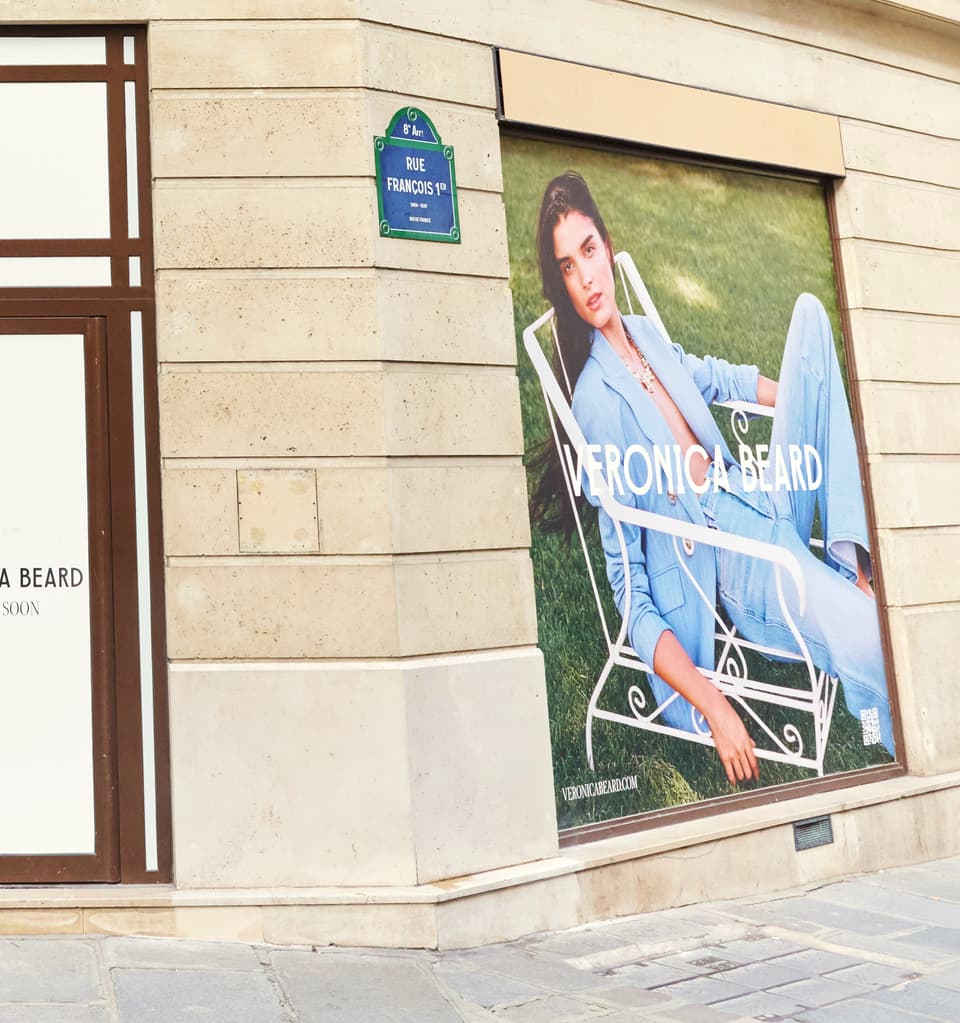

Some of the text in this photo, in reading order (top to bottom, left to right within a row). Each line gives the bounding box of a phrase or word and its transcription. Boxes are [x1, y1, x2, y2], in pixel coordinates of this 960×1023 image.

[406, 156, 426, 172] RUE
[387, 176, 434, 196] FRANÇOIS
[563, 444, 822, 497] VERONICA BEARD
[19, 567, 84, 588] BEARD
[1, 601, 41, 617] SOON
[561, 775, 640, 801] VERONICABEARD.COM
